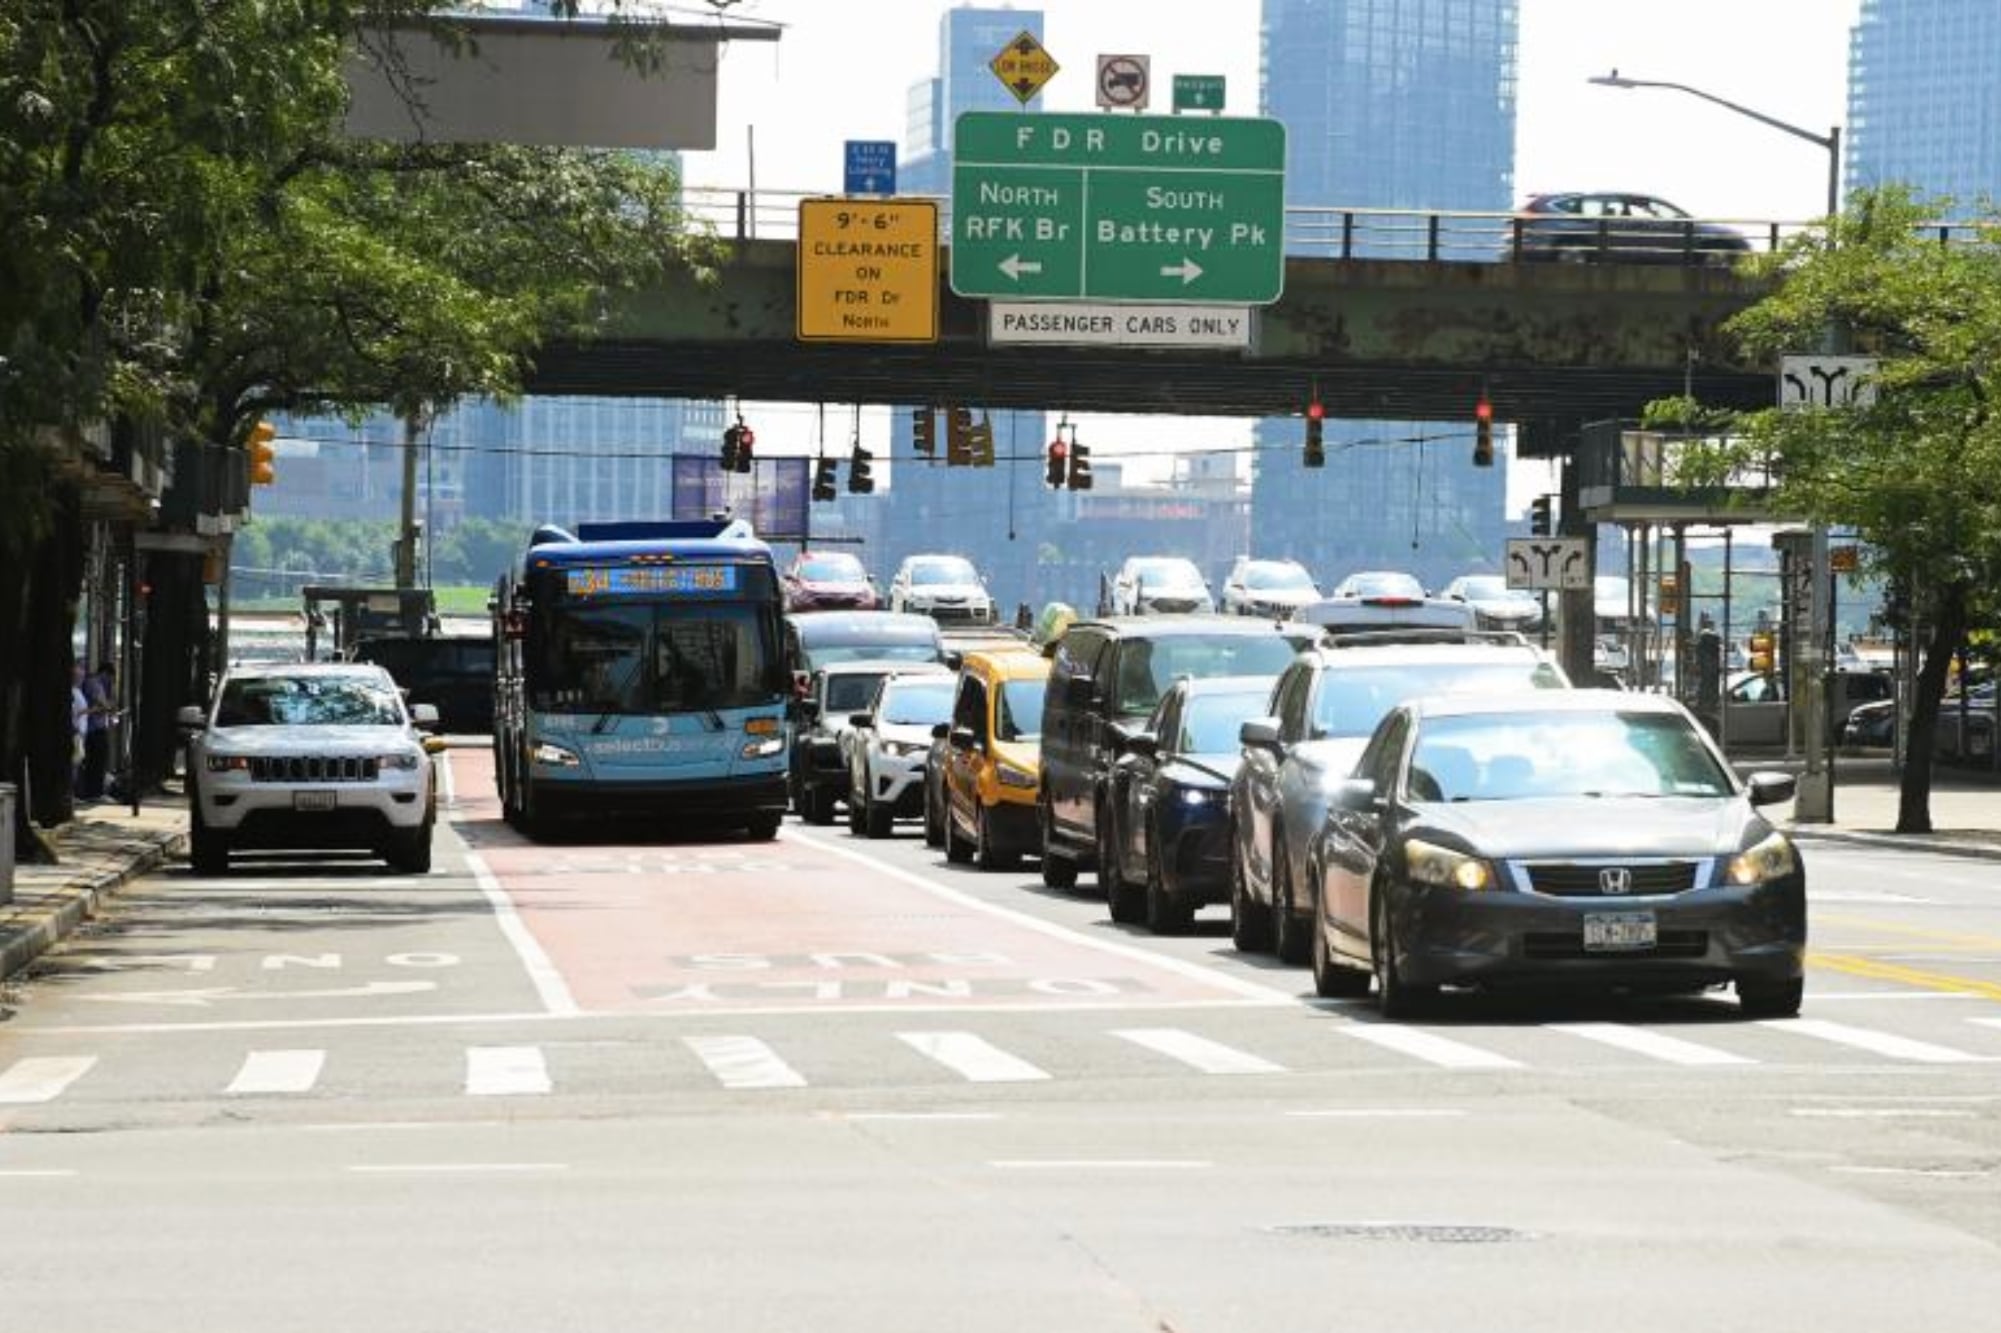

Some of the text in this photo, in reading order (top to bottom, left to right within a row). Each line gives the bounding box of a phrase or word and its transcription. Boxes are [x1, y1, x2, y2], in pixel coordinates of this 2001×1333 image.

[1141, 130, 1223, 154] Drive
[966, 216, 1070, 241] RFK Br
[1097, 220, 1267, 250] Battery Pk
[813, 242, 923, 258] CLEARANCE
[855, 266, 881, 280] ON
[834, 289, 869, 304] FDR
[1003, 313, 1240, 335] PASSENGER CARS ONLY
[690, 952, 1014, 969] BUS
[651, 977, 1123, 1000] ONLY
